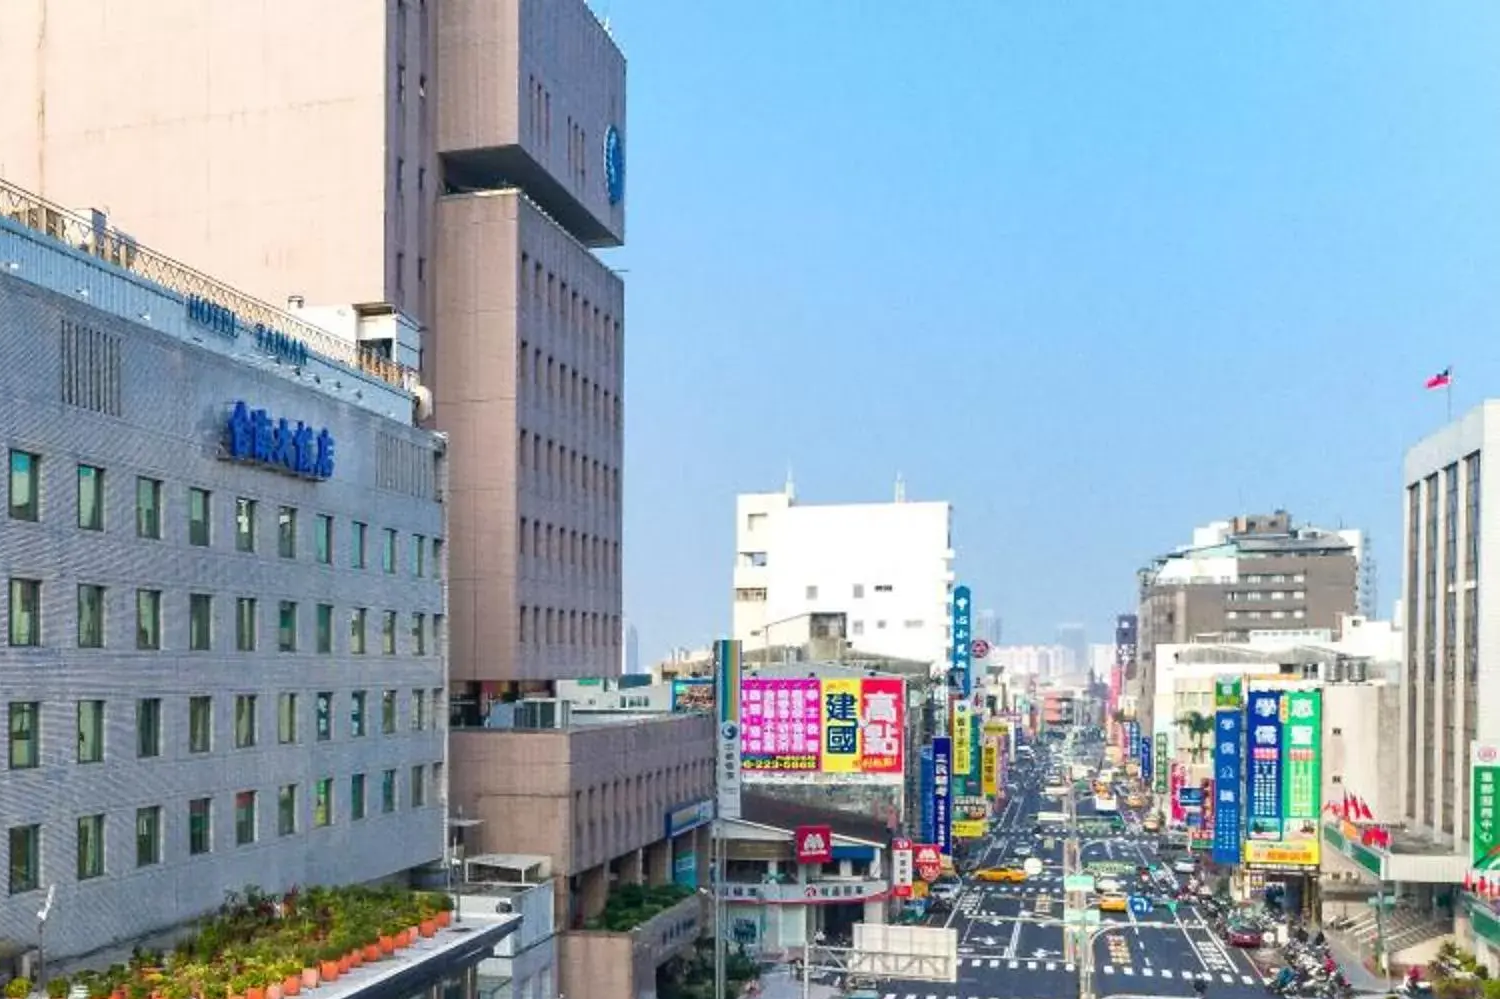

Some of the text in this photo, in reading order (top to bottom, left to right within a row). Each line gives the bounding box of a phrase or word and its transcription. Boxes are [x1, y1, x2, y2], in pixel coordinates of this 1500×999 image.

[187, 293, 239, 339] HOTEL
[825, 691, 858, 754] 建國
[862, 691, 899, 756] 高點
